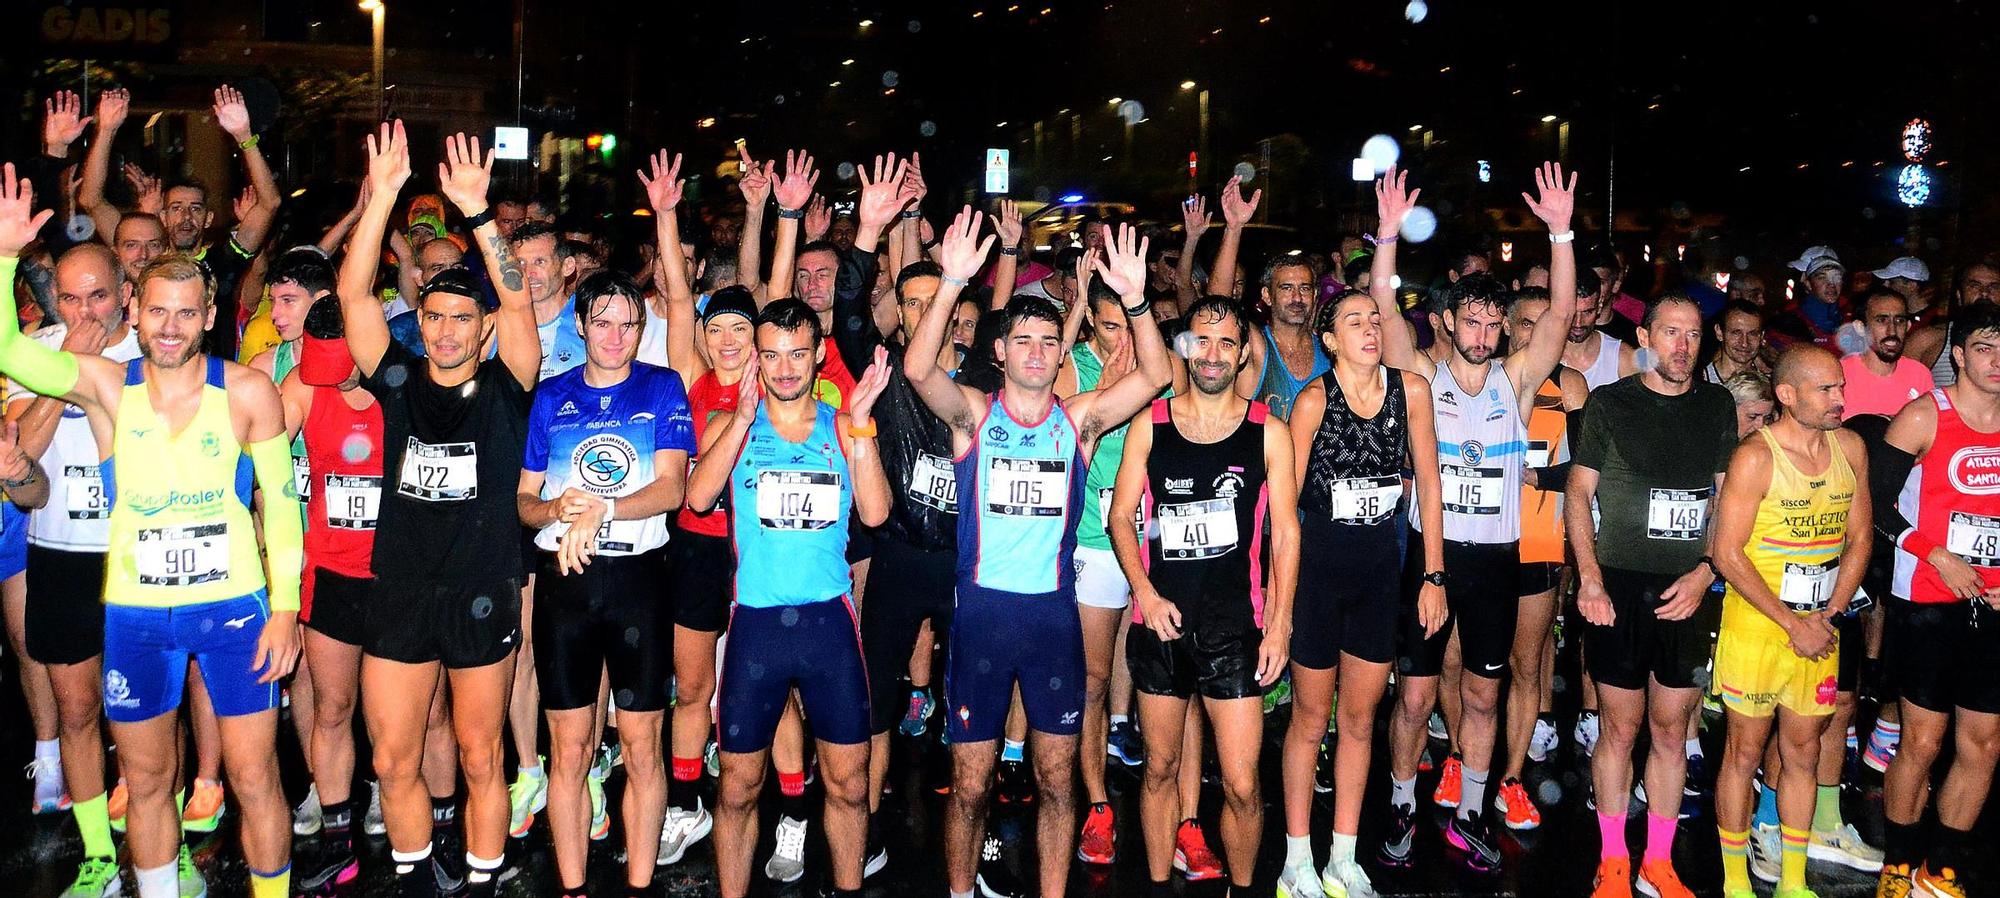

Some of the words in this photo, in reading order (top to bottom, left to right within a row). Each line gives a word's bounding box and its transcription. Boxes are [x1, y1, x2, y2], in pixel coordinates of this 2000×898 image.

[42, 6, 170, 42] GADIS
[590, 420, 621, 429] ABANCA
[574, 438, 598, 465] SOCIEDAD
[418, 464, 449, 488] 122
[581, 482, 628, 494] PONTEVEDRA
[929, 475, 956, 501] 180
[1010, 480, 1042, 504] 105
[1460, 484, 1481, 504] 115
[348, 496, 366, 518] 19
[780, 493, 814, 517] 104
[1356, 496, 1379, 517] 36
[1670, 508, 1698, 529] 148
[1183, 523, 1209, 546] 40
[1791, 527, 1811, 538] San
[1972, 535, 1998, 556] 48
[166, 549, 195, 574] 90
